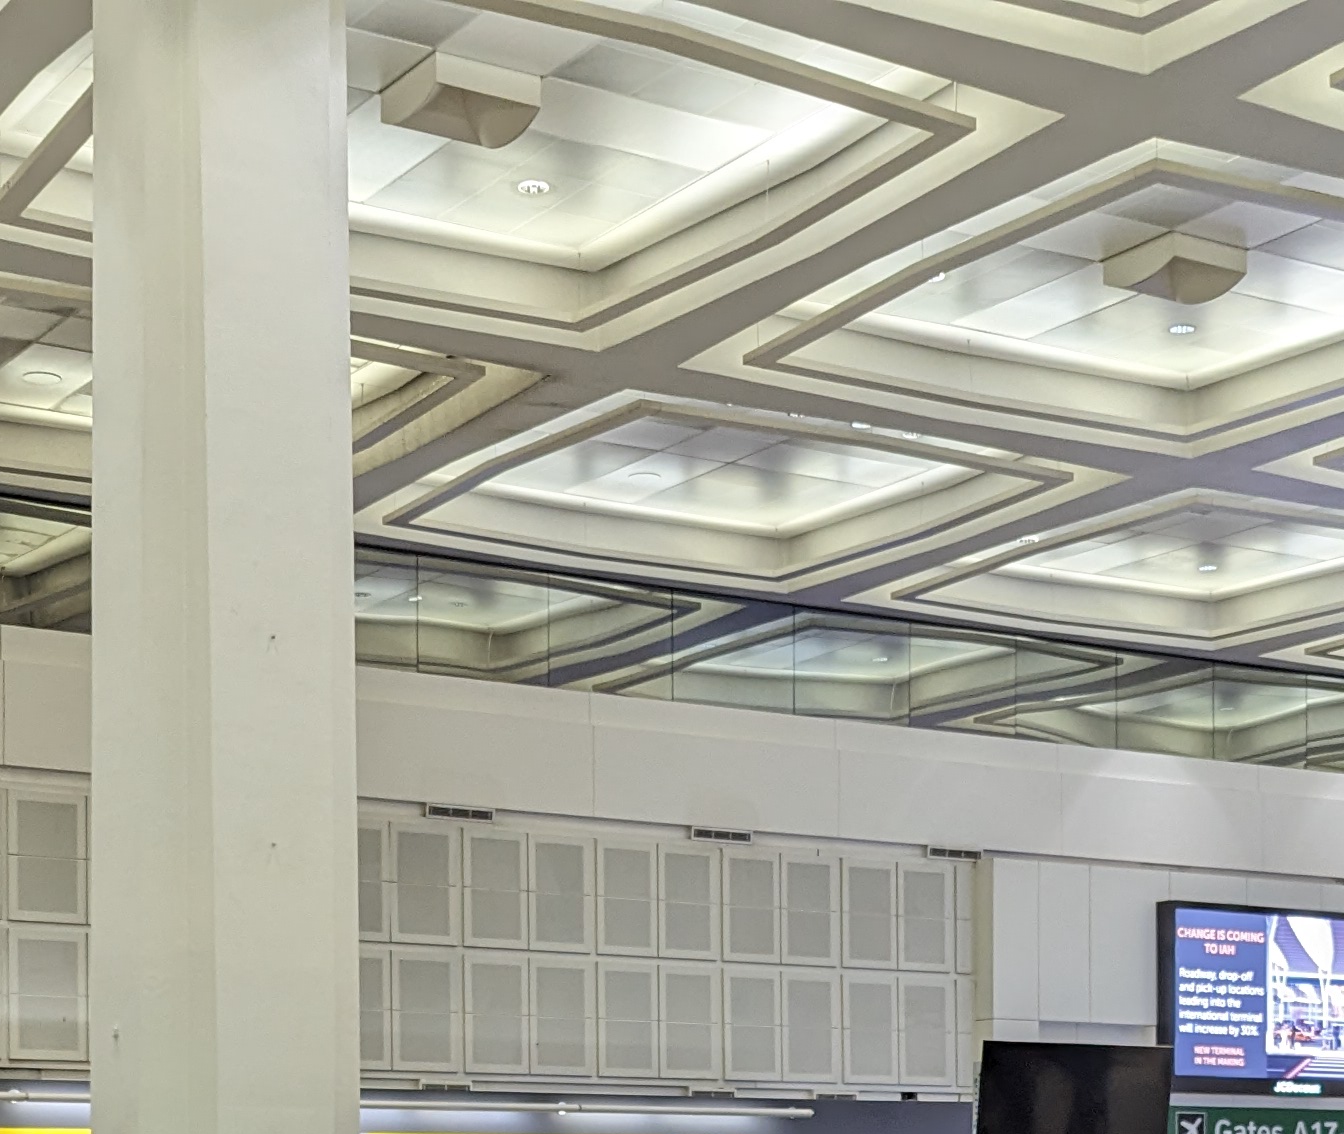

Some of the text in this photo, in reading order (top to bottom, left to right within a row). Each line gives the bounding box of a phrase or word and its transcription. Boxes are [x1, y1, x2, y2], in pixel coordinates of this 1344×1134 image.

[1177, 927, 1264, 944] CHANGE IS COMING
[1204, 943, 1235, 955] TO IAH
[1218, 970, 1254, 982] drop-off
[1179, 982, 1264, 996] and pick-up locations
[1179, 995, 1242, 1009] leading into the
[1179, 1009, 1263, 1023] international terminal
[1179, 1023, 1194, 1033] will
[1194, 1024, 1228, 1035] increase
[1228, 1025, 1240, 1037] by
[1194, 1046, 1245, 1057] NEW TERMINAL
